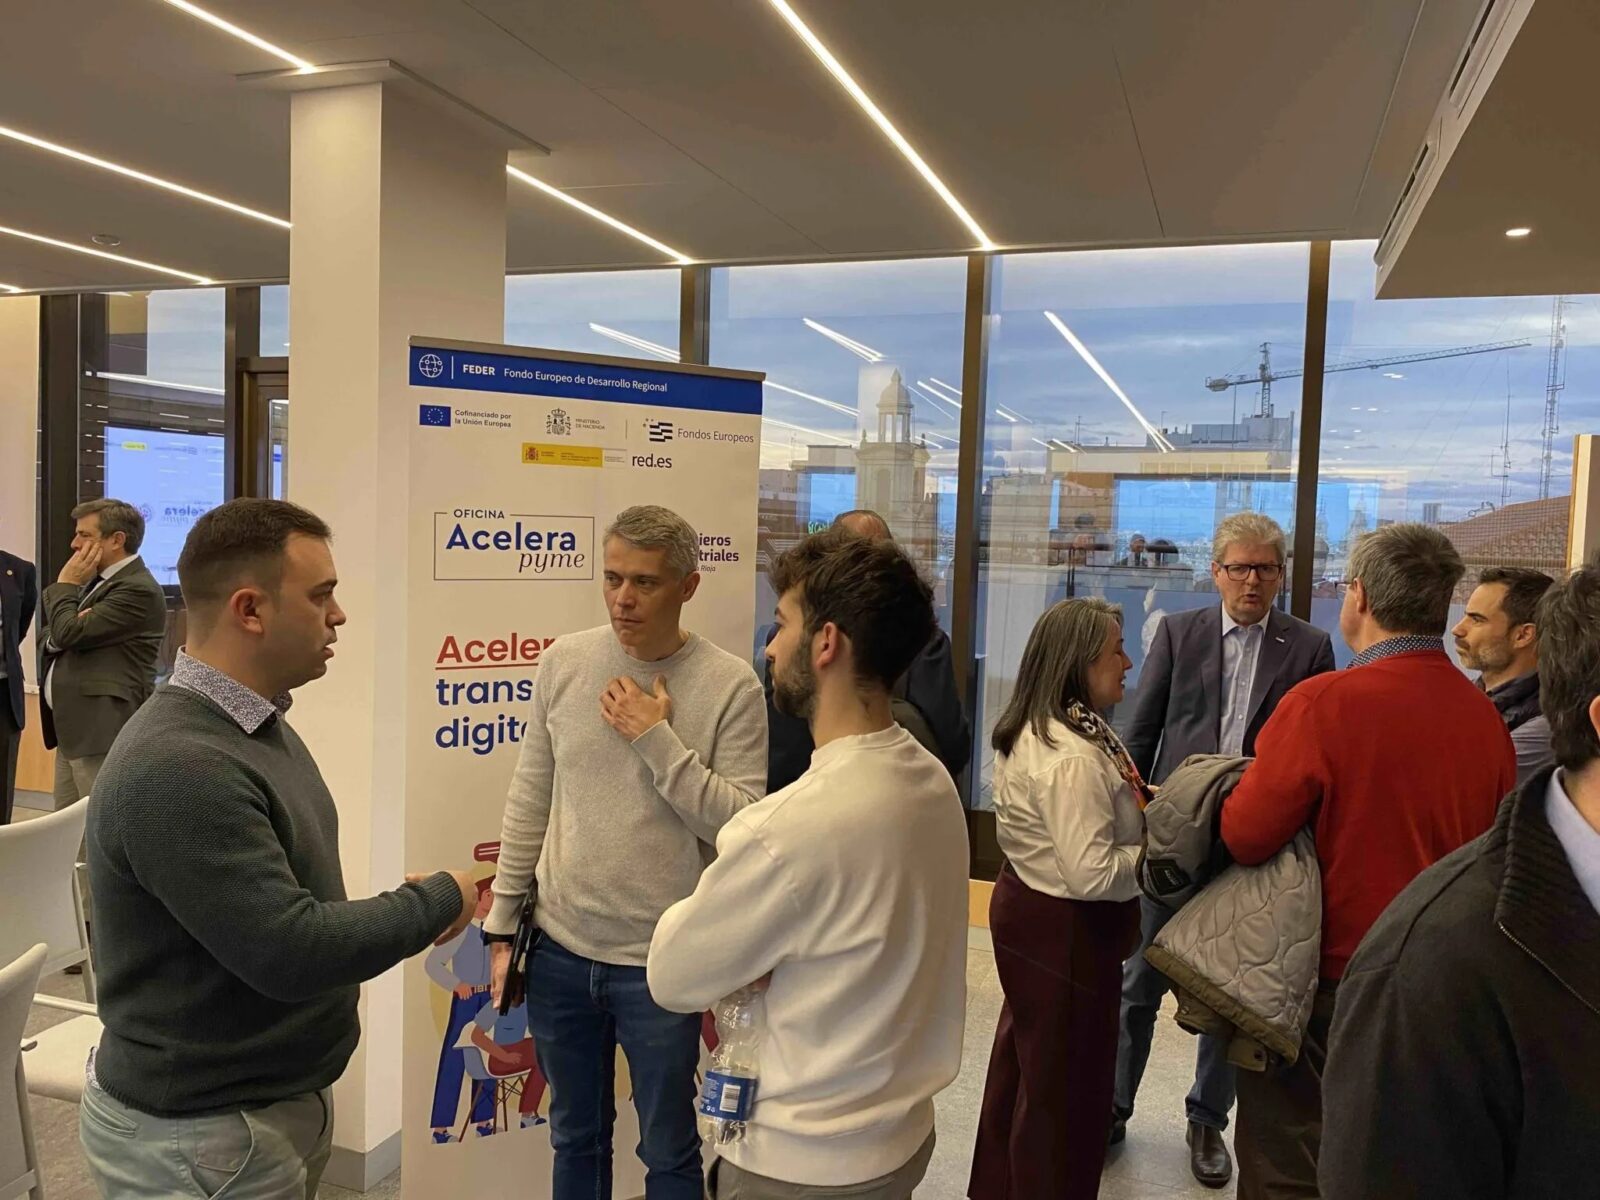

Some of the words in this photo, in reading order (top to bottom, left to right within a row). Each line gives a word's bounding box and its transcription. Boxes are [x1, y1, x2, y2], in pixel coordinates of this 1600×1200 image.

[463, 364, 495, 376] FEDER
[504, 368, 533, 379] Fondo
[535, 371, 573, 384] Europeo
[574, 375, 585, 384] de
[587, 376, 631, 389] Desarrollo
[633, 381, 667, 392] Regional
[455, 409, 499, 419] Cofinanciado
[462, 418, 482, 426] Unión
[484, 420, 512, 429] Europea
[678, 428, 711, 440] Fondos
[713, 431, 754, 444] Europeos
[632, 453, 672, 468] red.es
[453, 509, 505, 519] OFICINA
[446, 521, 576, 551] Acelera
[699, 533, 731, 546] ieros
[518, 552, 585, 574] pyme
[699, 549, 739, 562] triales
[701, 565, 716, 573] Rioja
[435, 679, 534, 706] trans
[435, 713, 528, 755] digit
